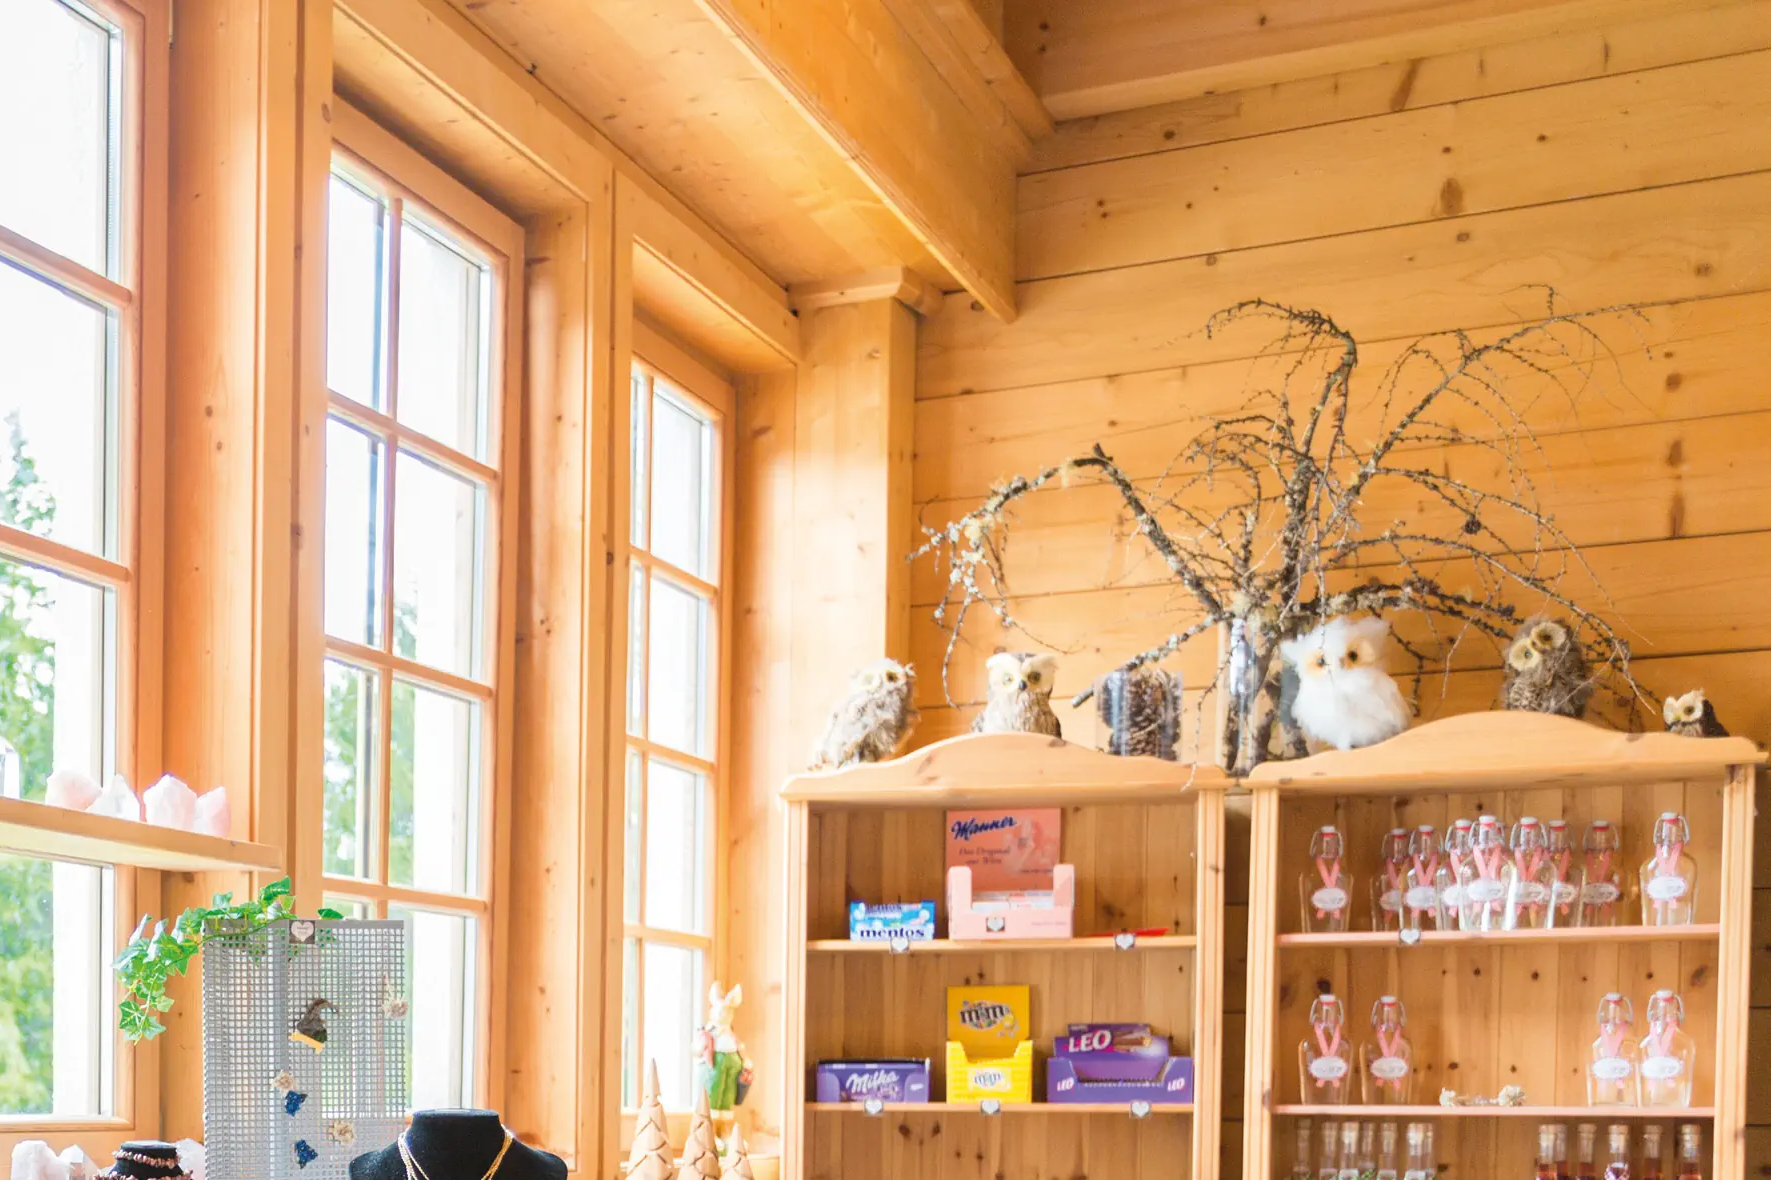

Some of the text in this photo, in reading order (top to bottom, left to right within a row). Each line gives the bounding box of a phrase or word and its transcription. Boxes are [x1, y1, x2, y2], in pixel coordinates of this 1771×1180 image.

[951, 817, 1017, 841] Manner
[860, 927, 924, 938] mentos
[1069, 1030, 1112, 1052] LEO
[846, 1069, 900, 1093] Milka
[1057, 1077, 1075, 1092] LEO
[1167, 1077, 1186, 1092] LEO
